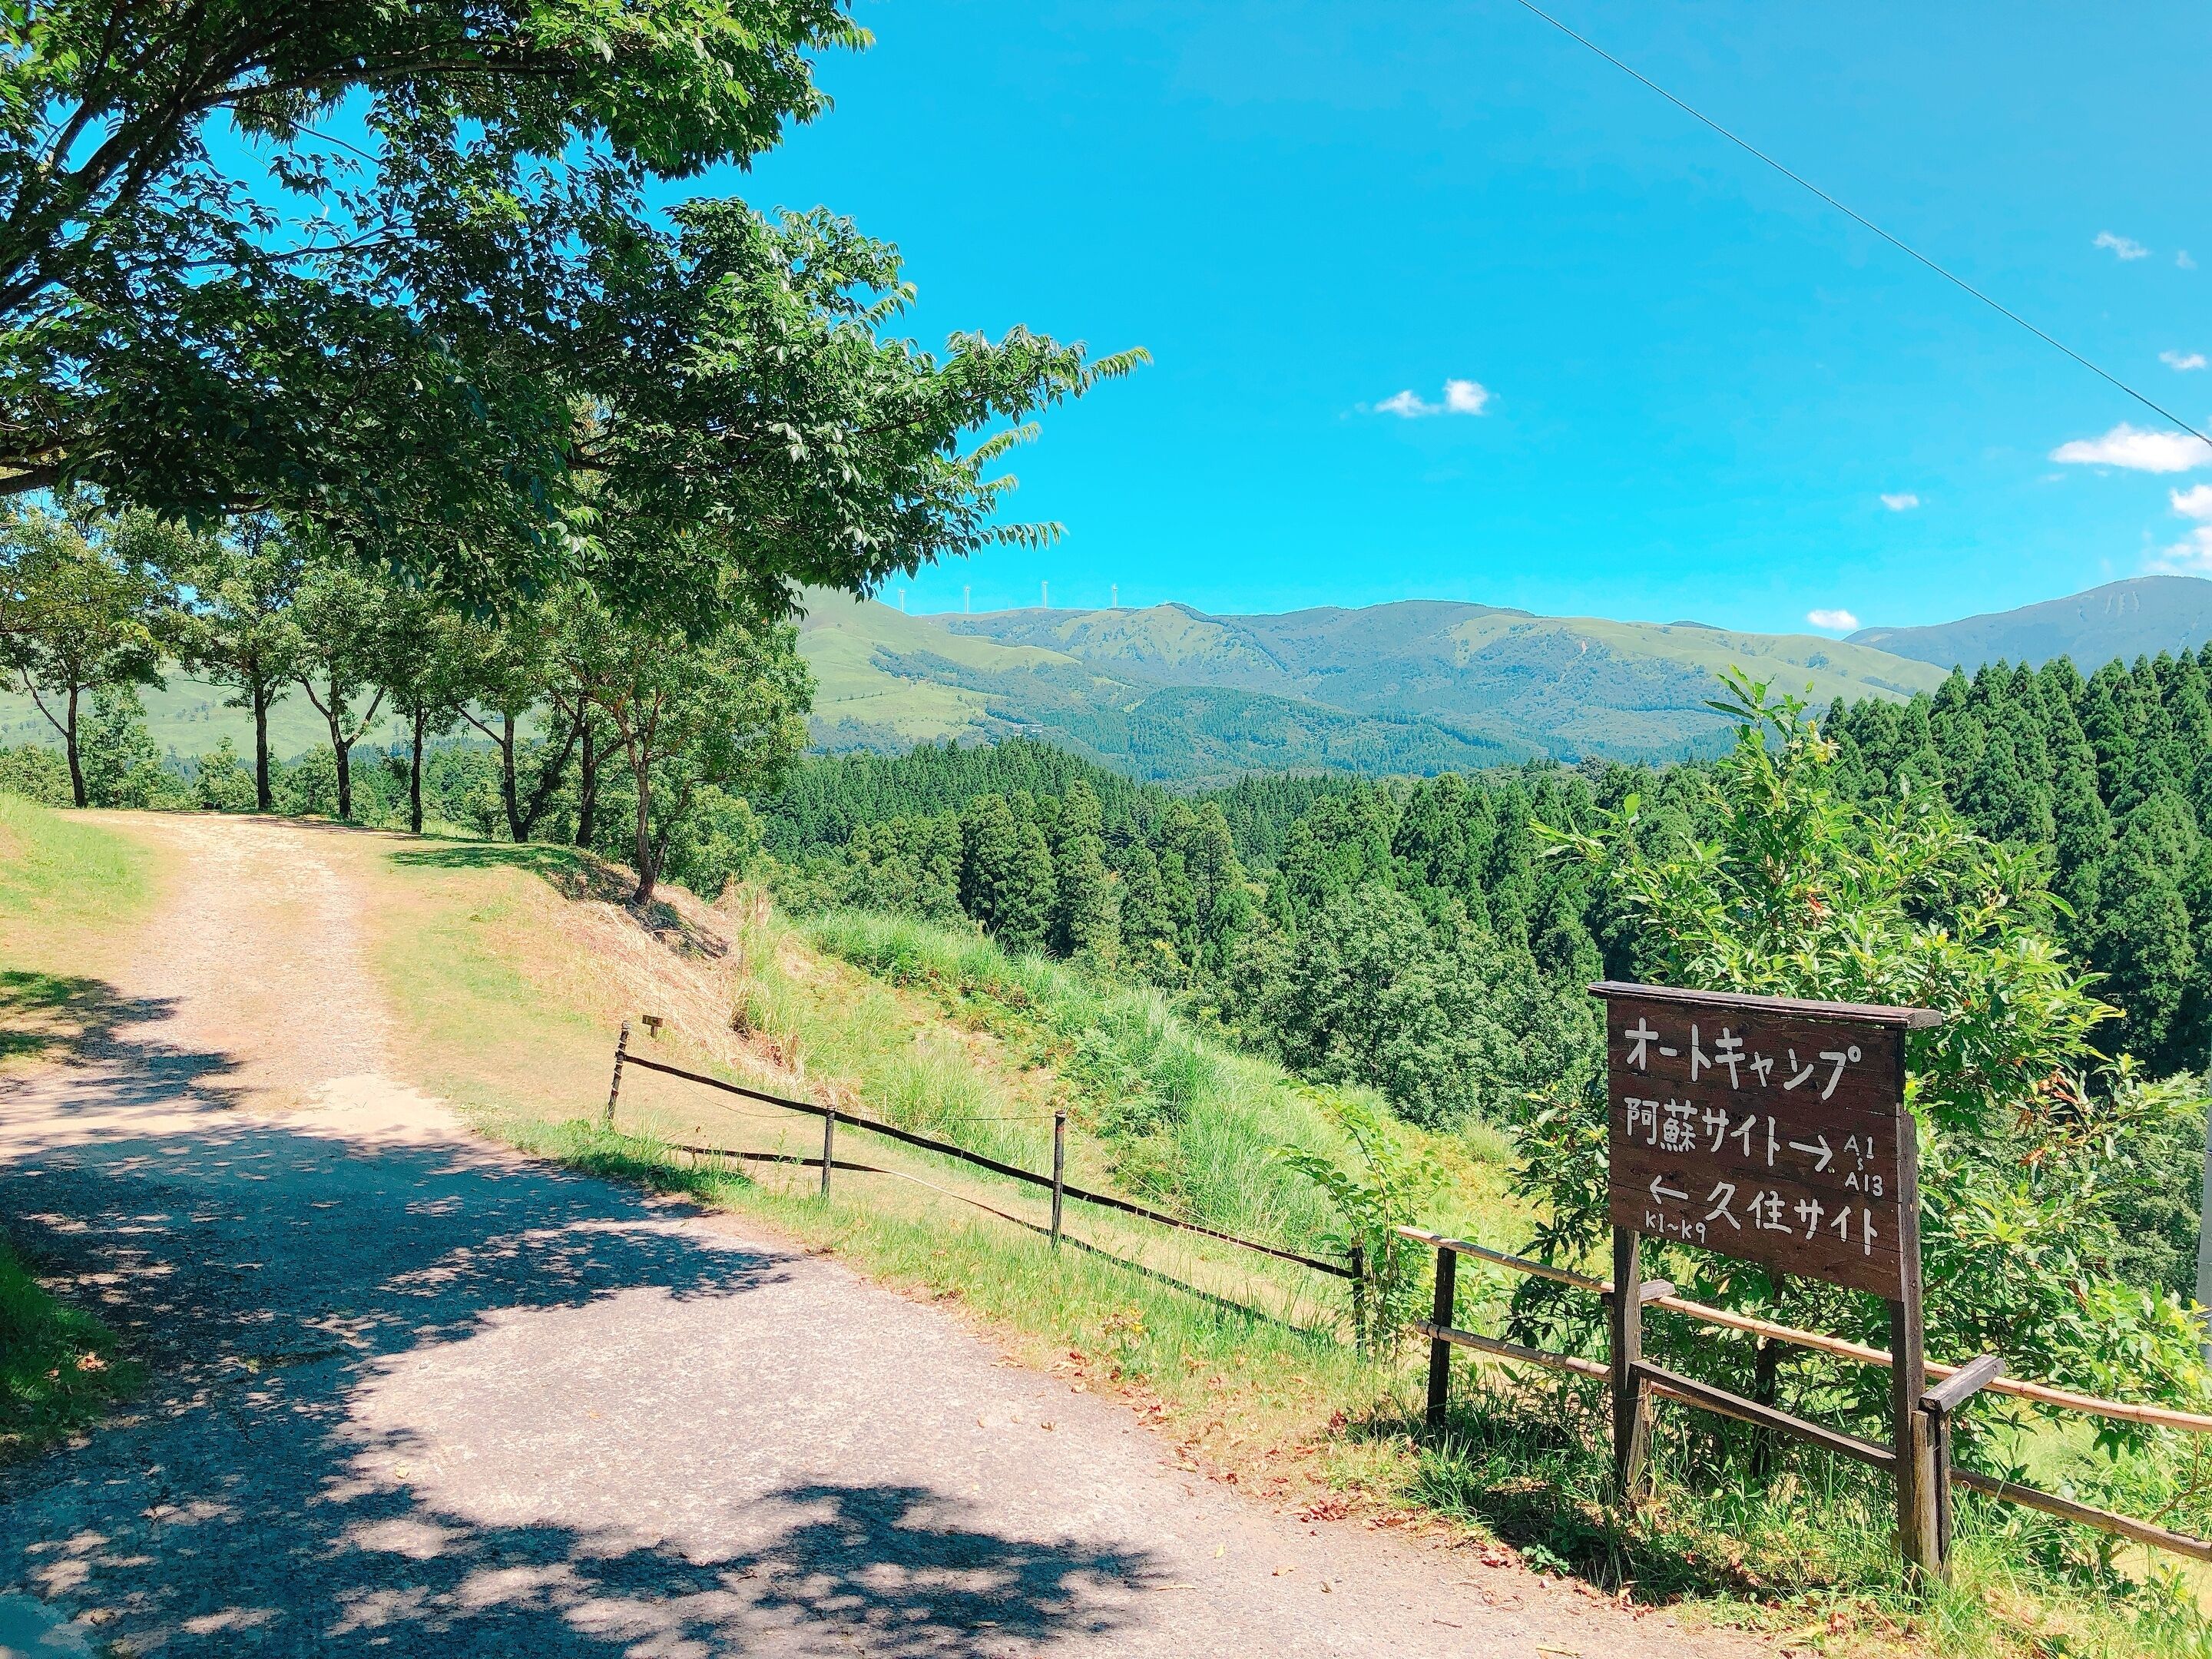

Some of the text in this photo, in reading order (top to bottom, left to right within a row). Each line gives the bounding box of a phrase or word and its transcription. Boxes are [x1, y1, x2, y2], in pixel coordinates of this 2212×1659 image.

[1624, 1018, 1862, 1100] オートキャンプ
[1624, 1098, 1780, 1167] 阿蘇サイト
[1843, 1134, 1874, 1159] A1
[1705, 1181, 1879, 1256] 久住サイト
[1845, 1171, 1883, 1197] A13
